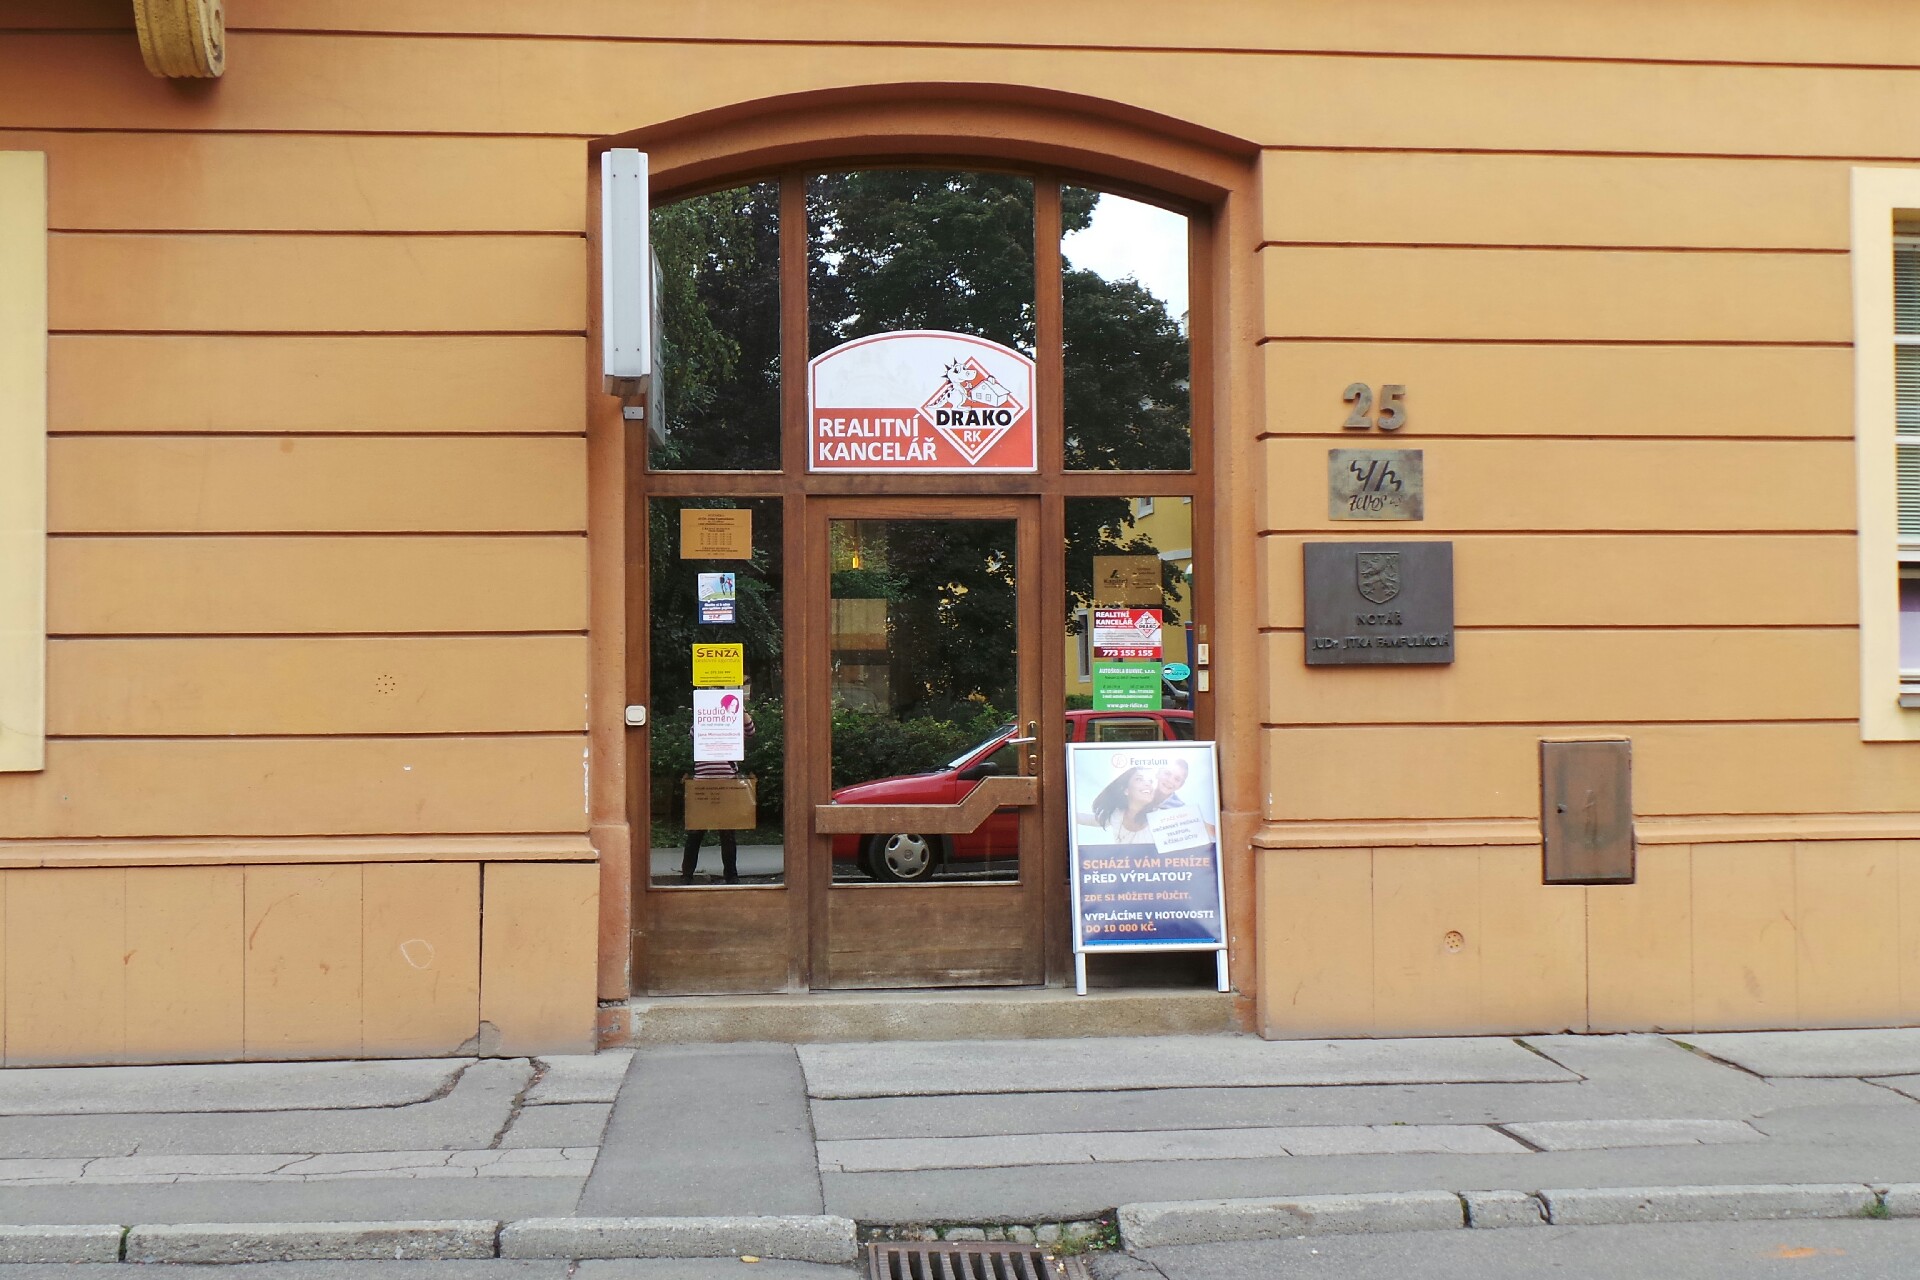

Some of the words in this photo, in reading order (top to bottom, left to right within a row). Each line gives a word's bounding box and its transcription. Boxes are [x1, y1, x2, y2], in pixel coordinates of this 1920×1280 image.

[1342, 381, 1406, 432] 25
[936, 410, 1012, 426] DRAKO
[819, 413, 921, 438] REALITNÍ
[964, 431, 982, 443] RK
[819, 437, 938, 461] KANCELÁŘ
[1096, 610, 1130, 618] REALITNÍ
[1356, 610, 1403, 626] NOTÁŘ
[1096, 618, 1134, 626] KANCELÁŘ
[1342, 636, 1373, 650] JITKA
[1376, 632, 1450, 649] FAMFULÍKOVÁ
[696, 648, 740, 658] SENZA
[697, 707, 726, 715] studio
[697, 715, 737, 724] proměny
[1130, 757, 1168, 766] Ferratum
[1083, 856, 1130, 869] SCHÁZÍ
[1134, 856, 1160, 869] VÁM
[1165, 854, 1210, 867] PENÍZE
[1083, 871, 1116, 883] PŘED
[1120, 869, 1192, 883] VÝPLATOU?
[1084, 894, 1102, 902] ZDE
[1118, 891, 1154, 901] MŮŽETE
[1156, 890, 1192, 900] PŮJČIT.
[1085, 910, 1143, 921] VYPLÁCÍME
[1144, 912, 1152, 920] V
[1155, 910, 1214, 919] HOTOVOSTI
[1086, 925, 1100, 933] DO
[1119, 924, 1138, 932] 000
[1141, 921, 1157, 932] KČ.
